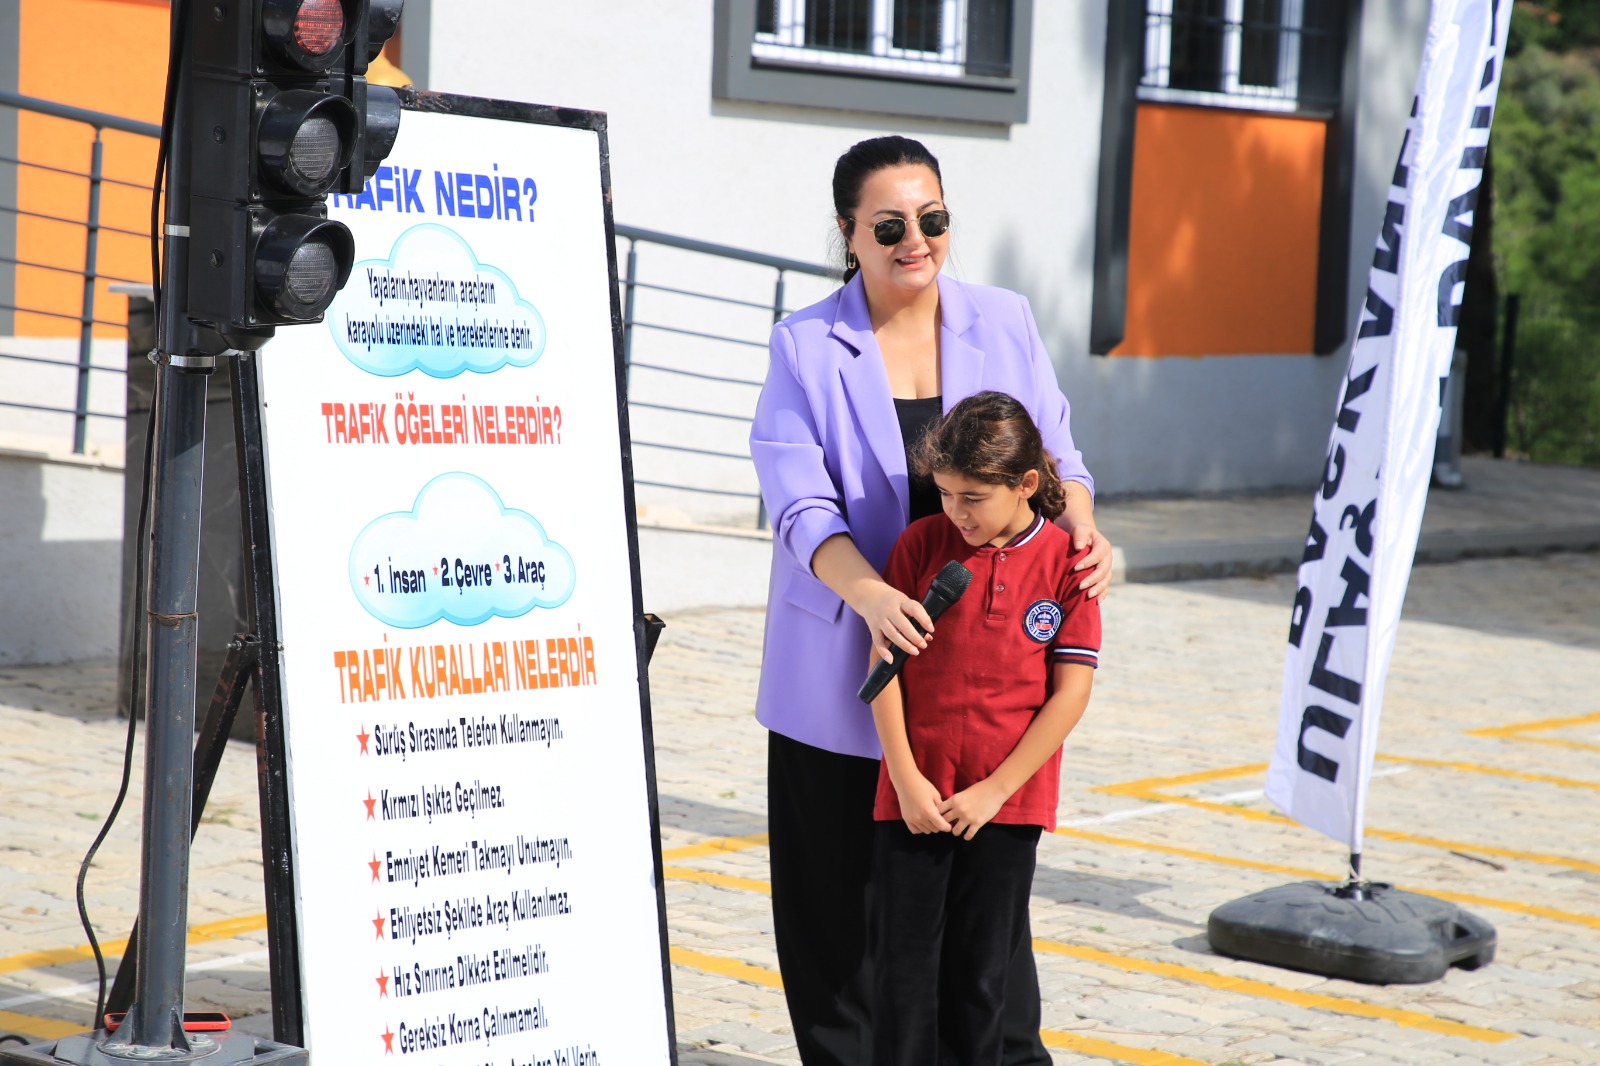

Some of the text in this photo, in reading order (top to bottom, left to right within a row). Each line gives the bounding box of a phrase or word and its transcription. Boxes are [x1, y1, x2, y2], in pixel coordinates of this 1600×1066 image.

[434, 162, 538, 222] NEDİR?
[460, 274, 496, 311] araçların
[346, 313, 533, 352] karayolu üzerindeki hal ve hareketlerine denir.
[394, 391, 468, 445] ÖĞELERİ
[472, 395, 562, 444] NELERDİR?
[388, 556, 426, 594] İnsan
[334, 623, 597, 704] TRAFİK KURALLARI NELERDİR
[375, 713, 563, 762] Sürüş Sırasında Telefon Kullanmayın.
[381, 780, 505, 824] Kırmızı Işıkta Geçilmez.
[386, 834, 572, 887] Emniyet Kemeri Takmayı Unutmayın.
[390, 887, 572, 945] Ehliyetsiz Şekilde Araç Kullanılmaz.
[394, 944, 549, 998] Hız Sınırına Dikkat Edilmelidir.
[399, 998, 548, 1054] Gereksiz Korna Çalınmamalı.
